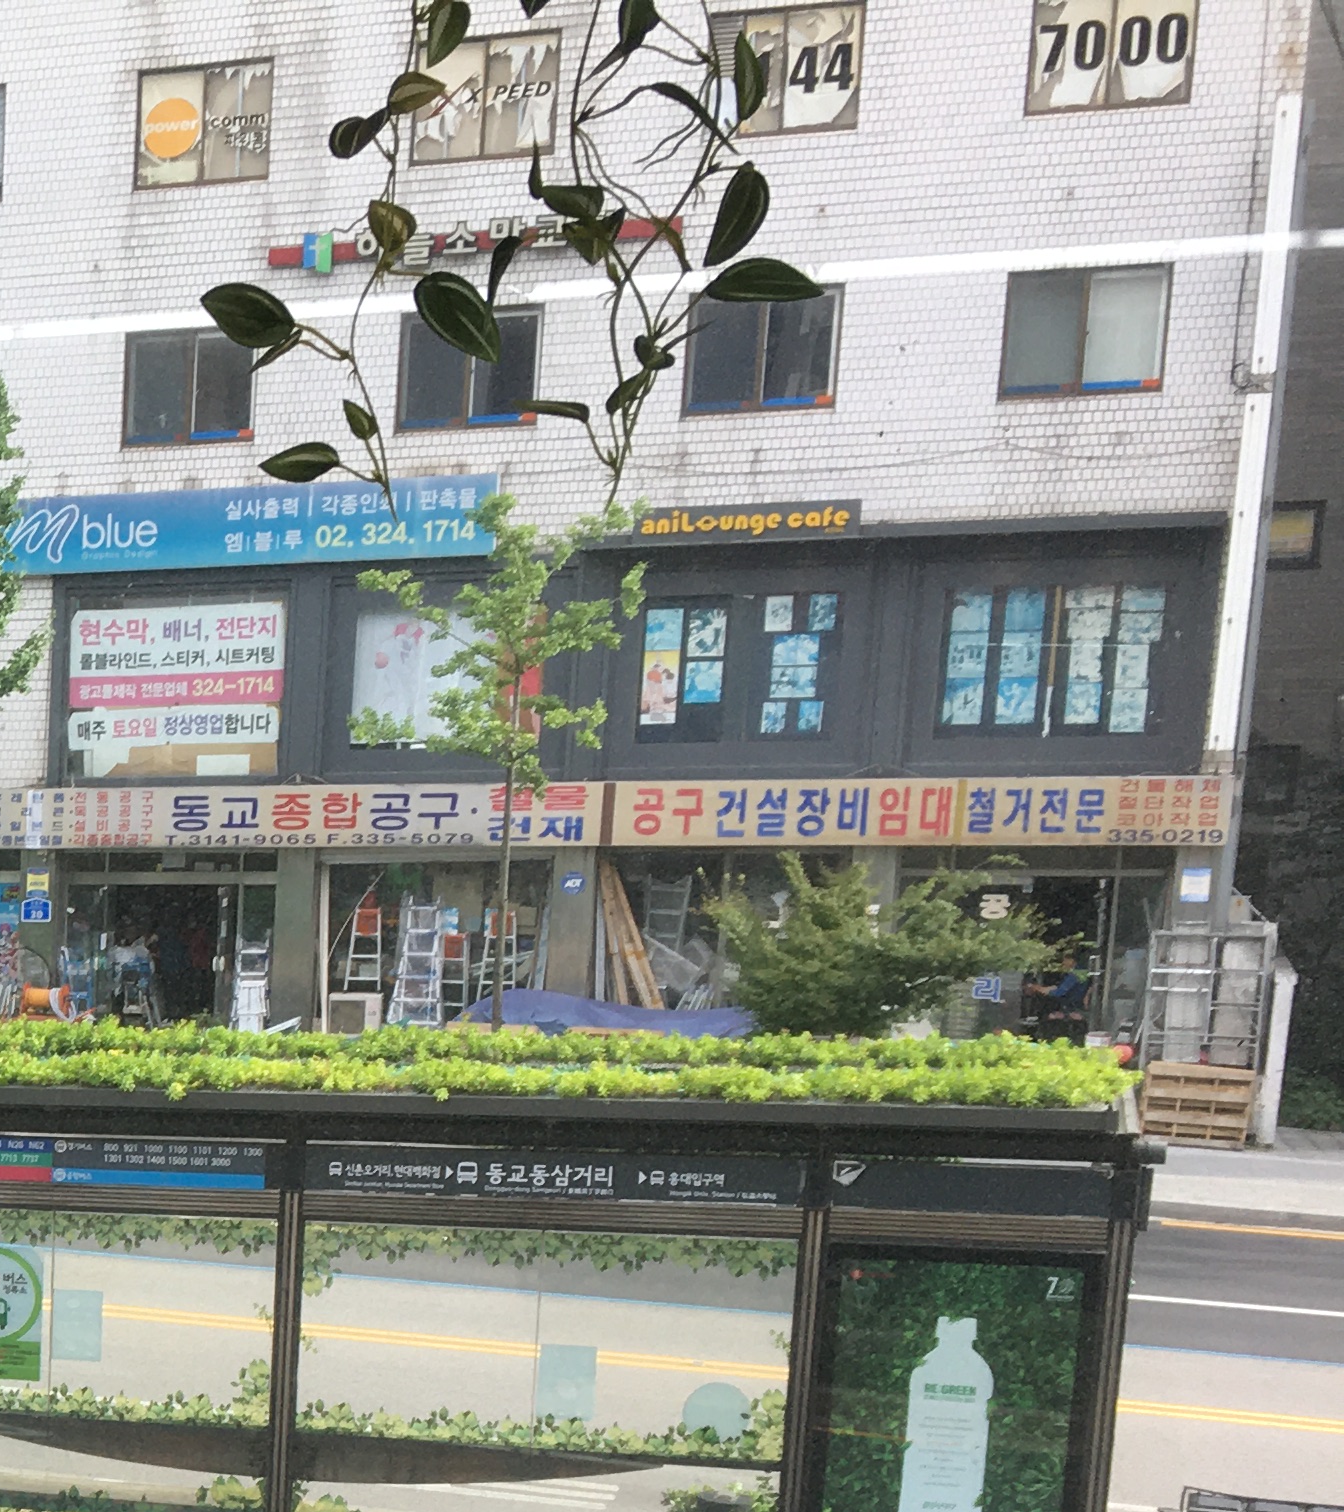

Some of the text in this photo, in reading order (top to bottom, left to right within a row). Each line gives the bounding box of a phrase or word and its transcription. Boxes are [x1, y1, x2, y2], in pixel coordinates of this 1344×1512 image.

[144, 113, 266, 134] power comm
[224, 496, 301, 521] 실사출력
[420, 487, 478, 511] 판촉물
[786, 506, 851, 528] cafe
[82, 512, 159, 549] blue
[422, 518, 477, 543] 1714
[215, 614, 278, 641] 전단지
[215, 646, 275, 666] 시트커팅
[192, 676, 275, 697] 324-1714
[77, 713, 272, 741] 매주 토요일 정상영업합니다
[967, 786, 1105, 834] 철거전문
[165, 832, 474, 847] T.3141-9065 F.335-5079
[485, 1162, 614, 1187] 동교동삼거리
[668, 1172, 725, 1187] 홍대입구역
[2, 1273, 28, 1285] 버스
